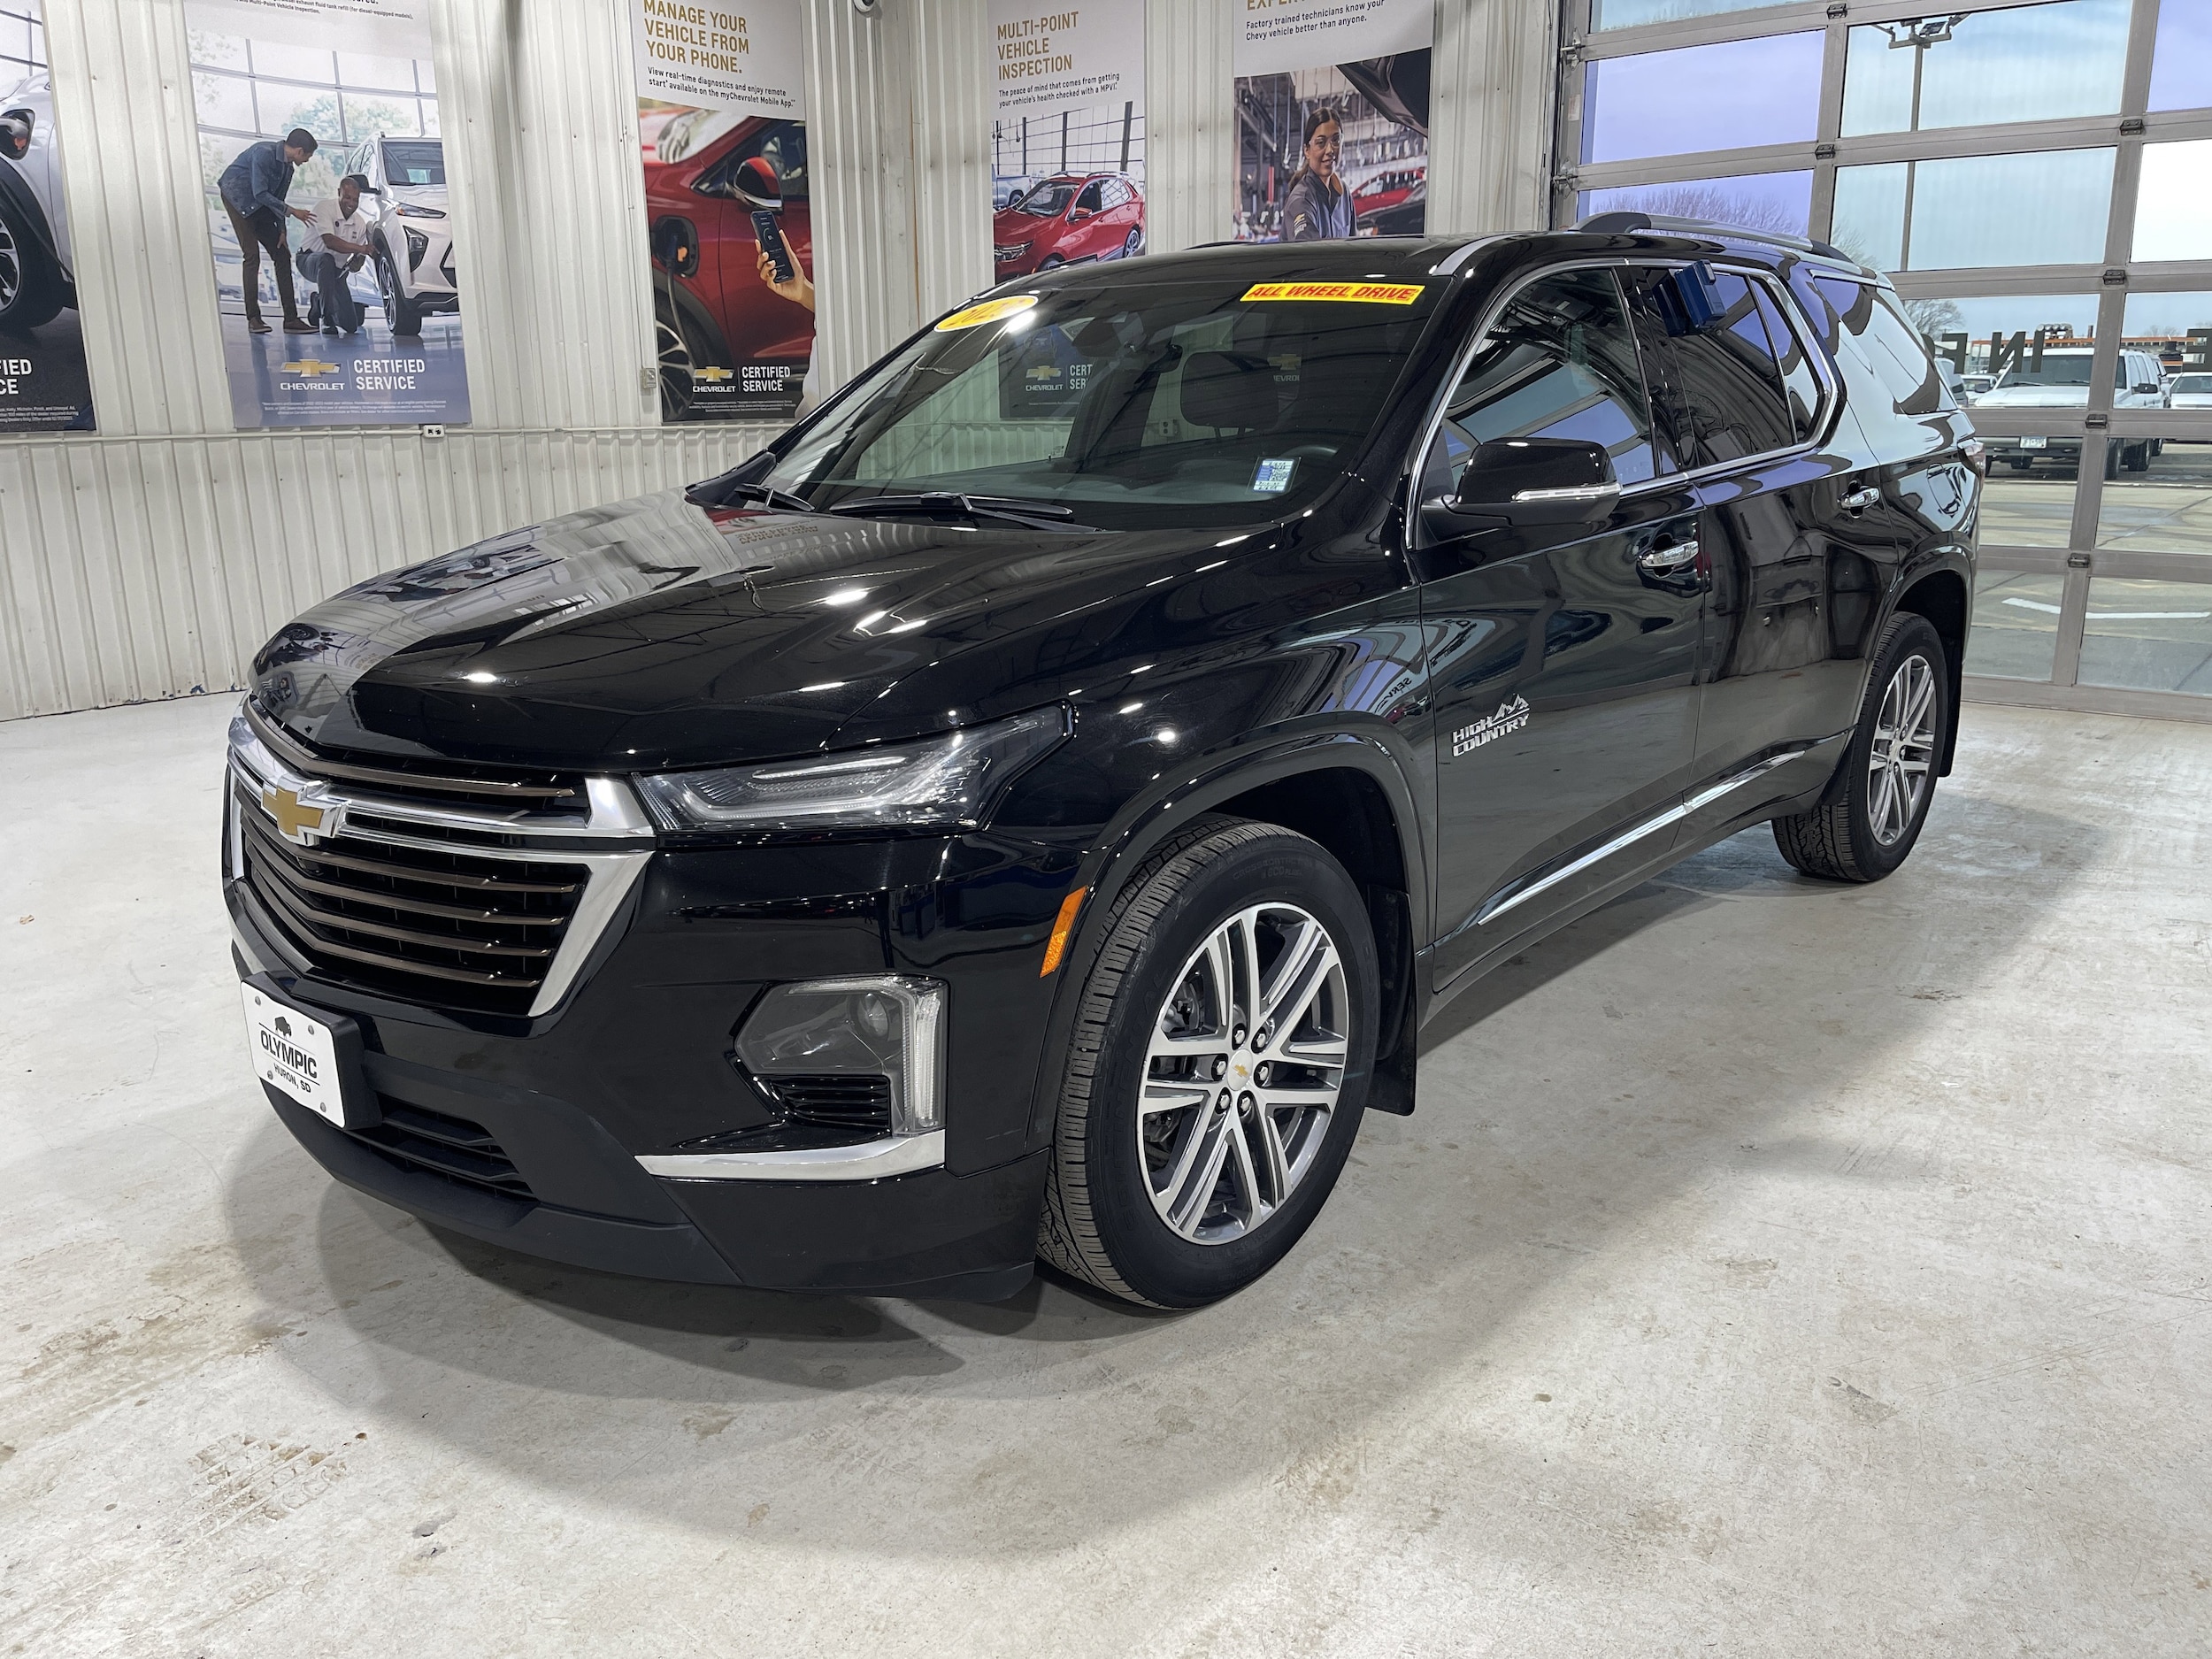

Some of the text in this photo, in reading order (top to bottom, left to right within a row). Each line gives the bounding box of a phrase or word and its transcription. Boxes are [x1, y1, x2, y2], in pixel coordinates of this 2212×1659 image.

[358, 8, 394, 17] diesel-equipped
[643, 0, 747, 33] MANAGE YOUR
[1246, 0, 1385, 29] Factory trained technicians know your
[644, 18, 749, 54] VEHICLE FROM
[997, 11, 1079, 41] MULTI-POINT
[1246, 15, 1367, 41] Chevy vehicle better than anyone.
[646, 39, 742, 73] YOUR PHONE.
[997, 37, 1049, 60] VEHICLE
[998, 54, 1072, 81] INSPECTION
[648, 66, 664, 77] View
[665, 71, 696, 83] real-time
[698, 76, 733, 90] diagnostics
[748, 85, 764, 96] enjoy
[764, 87, 786, 96] remote
[669, 82, 697, 95] available
[709, 88, 719, 97] the
[720, 91, 759, 104] myChevrolet
[760, 96, 779, 106] Mobile
[1010, 87, 1026, 97] peace
[1027, 85, 1033, 94] of
[1034, 82, 1048, 92] mind
[1049, 81, 1062, 90] that
[1082, 76, 1097, 85] from
[1098, 73, 1120, 84] getting
[999, 100, 1012, 109] your
[1012, 96, 1036, 105] vehicle's
[1037, 93, 1056, 102] health
[1056, 88, 1079, 100] checked
[1247, 286, 1417, 301] ALL WHEEL DRIVE
[354, 358, 426, 374] CERTIFIED
[741, 365, 791, 379] CERTIFIED
[356, 376, 416, 390] SERVICE
[742, 380, 783, 392] SERVICE
[1452, 715, 1493, 743] HIGH
[1452, 713, 1530, 757] COUNTRY
[260, 1030, 318, 1079] OLYMPIC
[273, 1063, 311, 1093] HURON, SD
